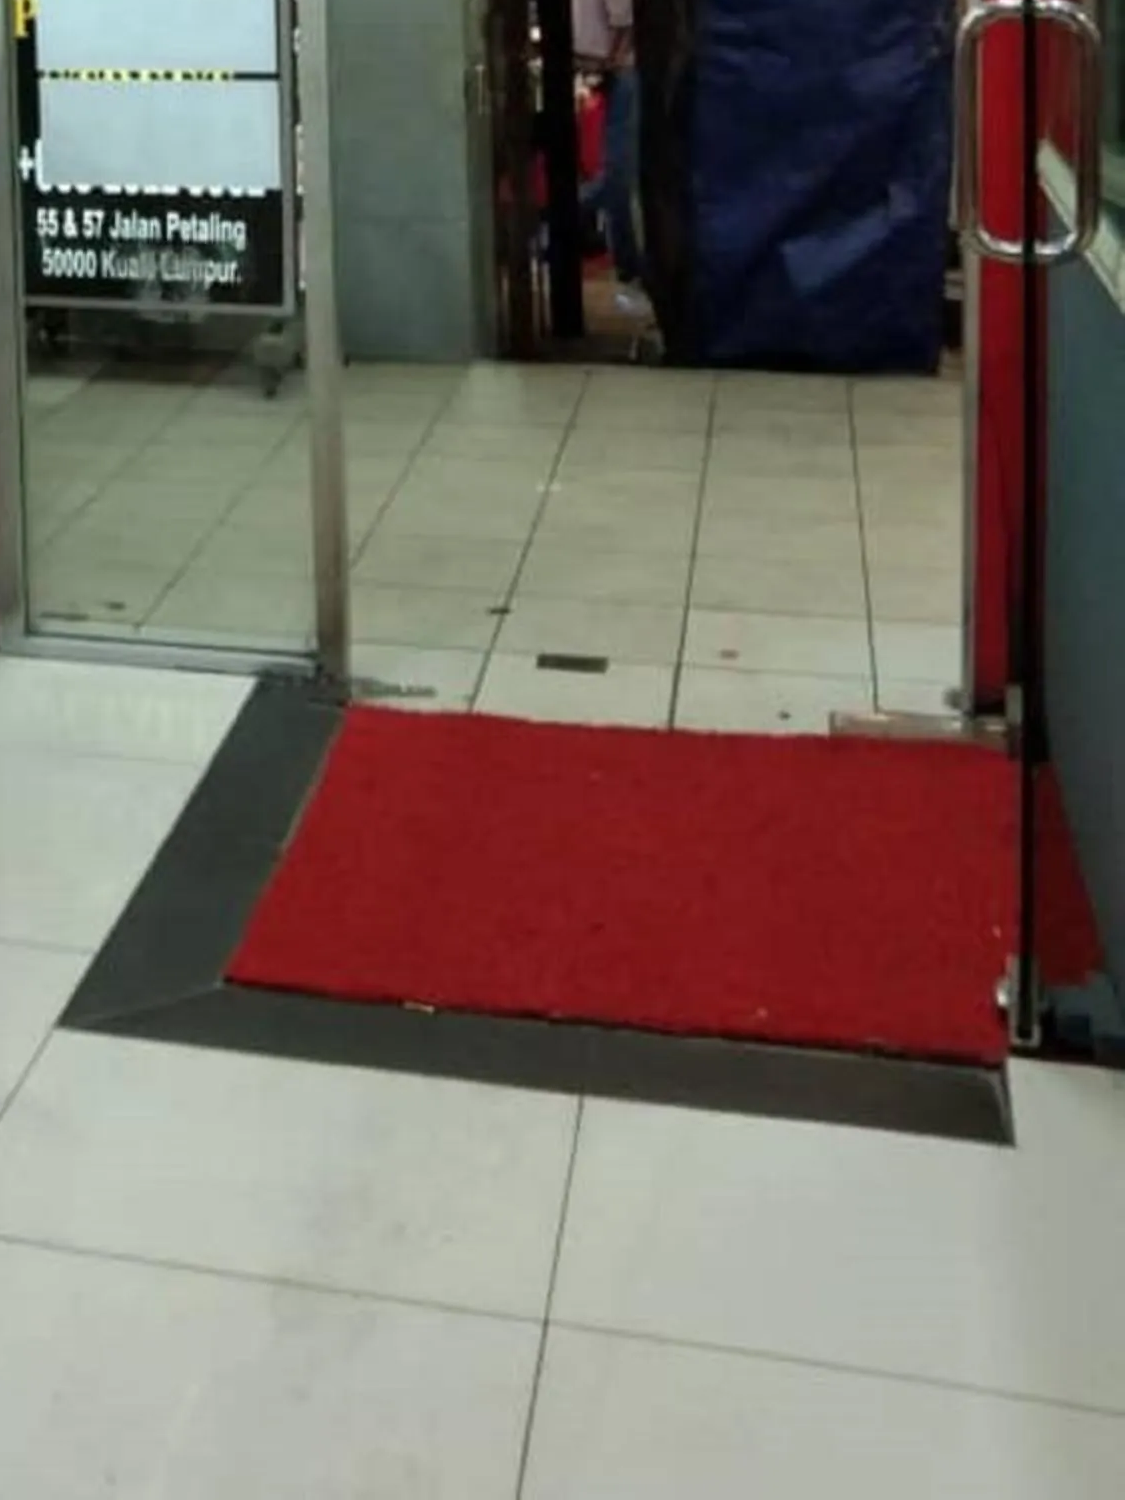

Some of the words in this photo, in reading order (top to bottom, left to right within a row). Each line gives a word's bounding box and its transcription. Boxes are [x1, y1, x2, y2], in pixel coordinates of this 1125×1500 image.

[36, 207, 60, 238] 55
[62, 207, 79, 240] &
[82, 208, 105, 239] 57
[109, 208, 162, 241] Jalan
[166, 210, 247, 252] Petaling
[42, 248, 98, 278] 50000
